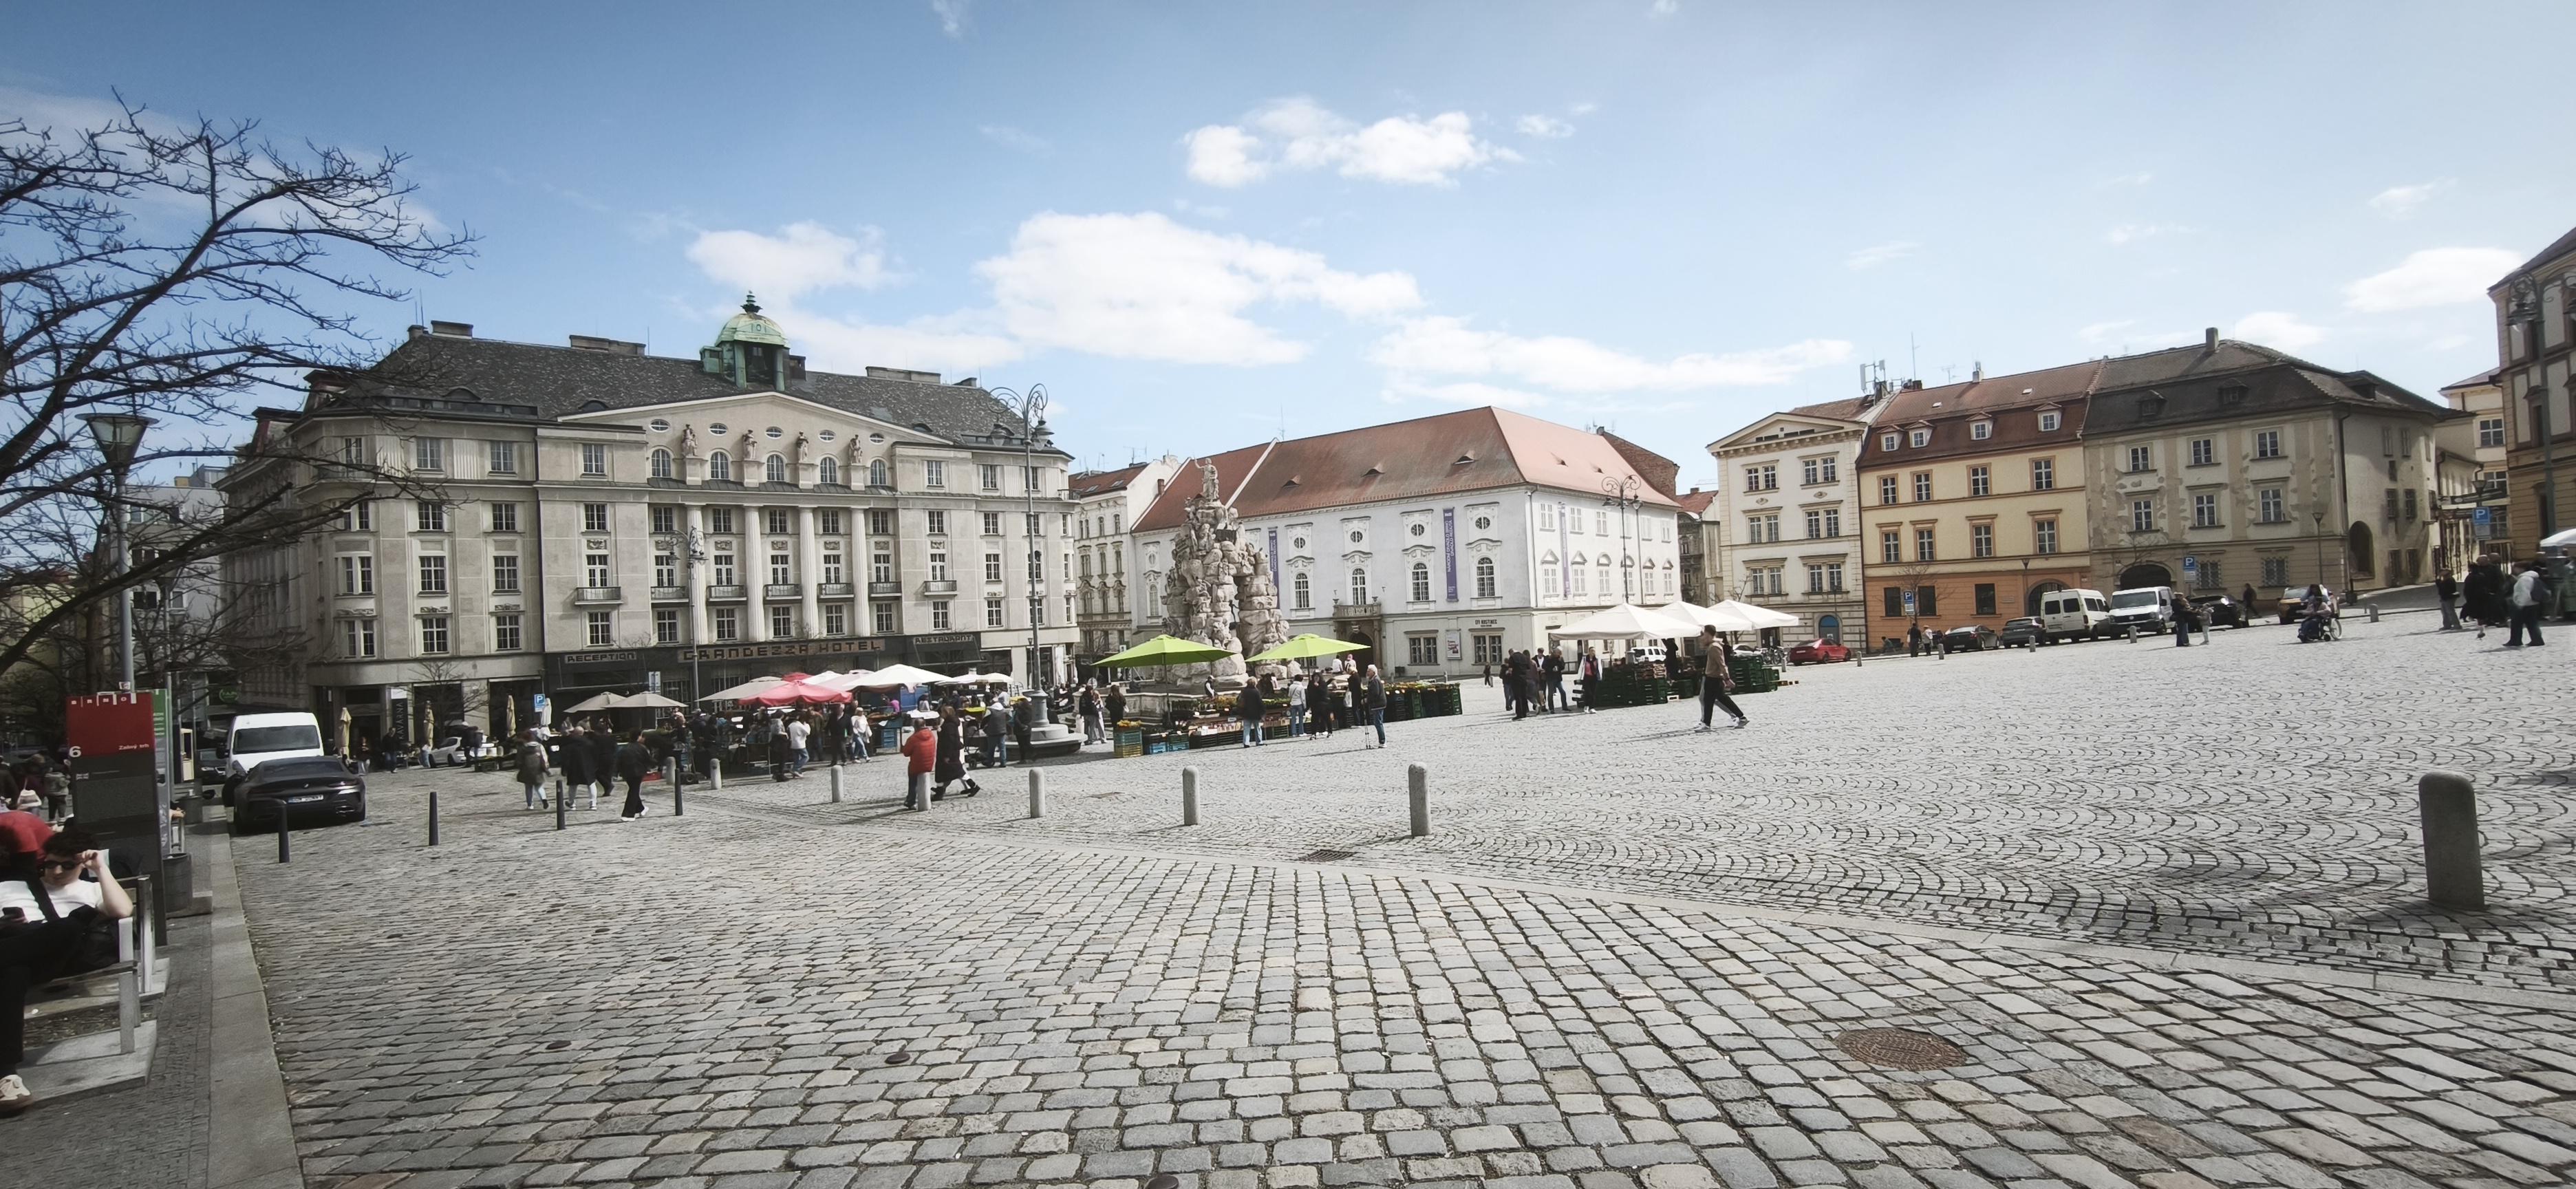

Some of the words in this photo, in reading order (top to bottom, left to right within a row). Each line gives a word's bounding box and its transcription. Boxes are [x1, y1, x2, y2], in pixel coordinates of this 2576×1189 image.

[2476, 509, 2485, 519] P
[2185, 557, 2193, 566] P
[1904, 592, 1911, 600] P
[915, 635, 972, 644] RESTAURANT
[683, 644, 809, 661] GRANDEZZA
[819, 640, 880, 654] HOTEL
[568, 653, 635, 662] RECEPTION
[69, 745, 82, 758] 6
